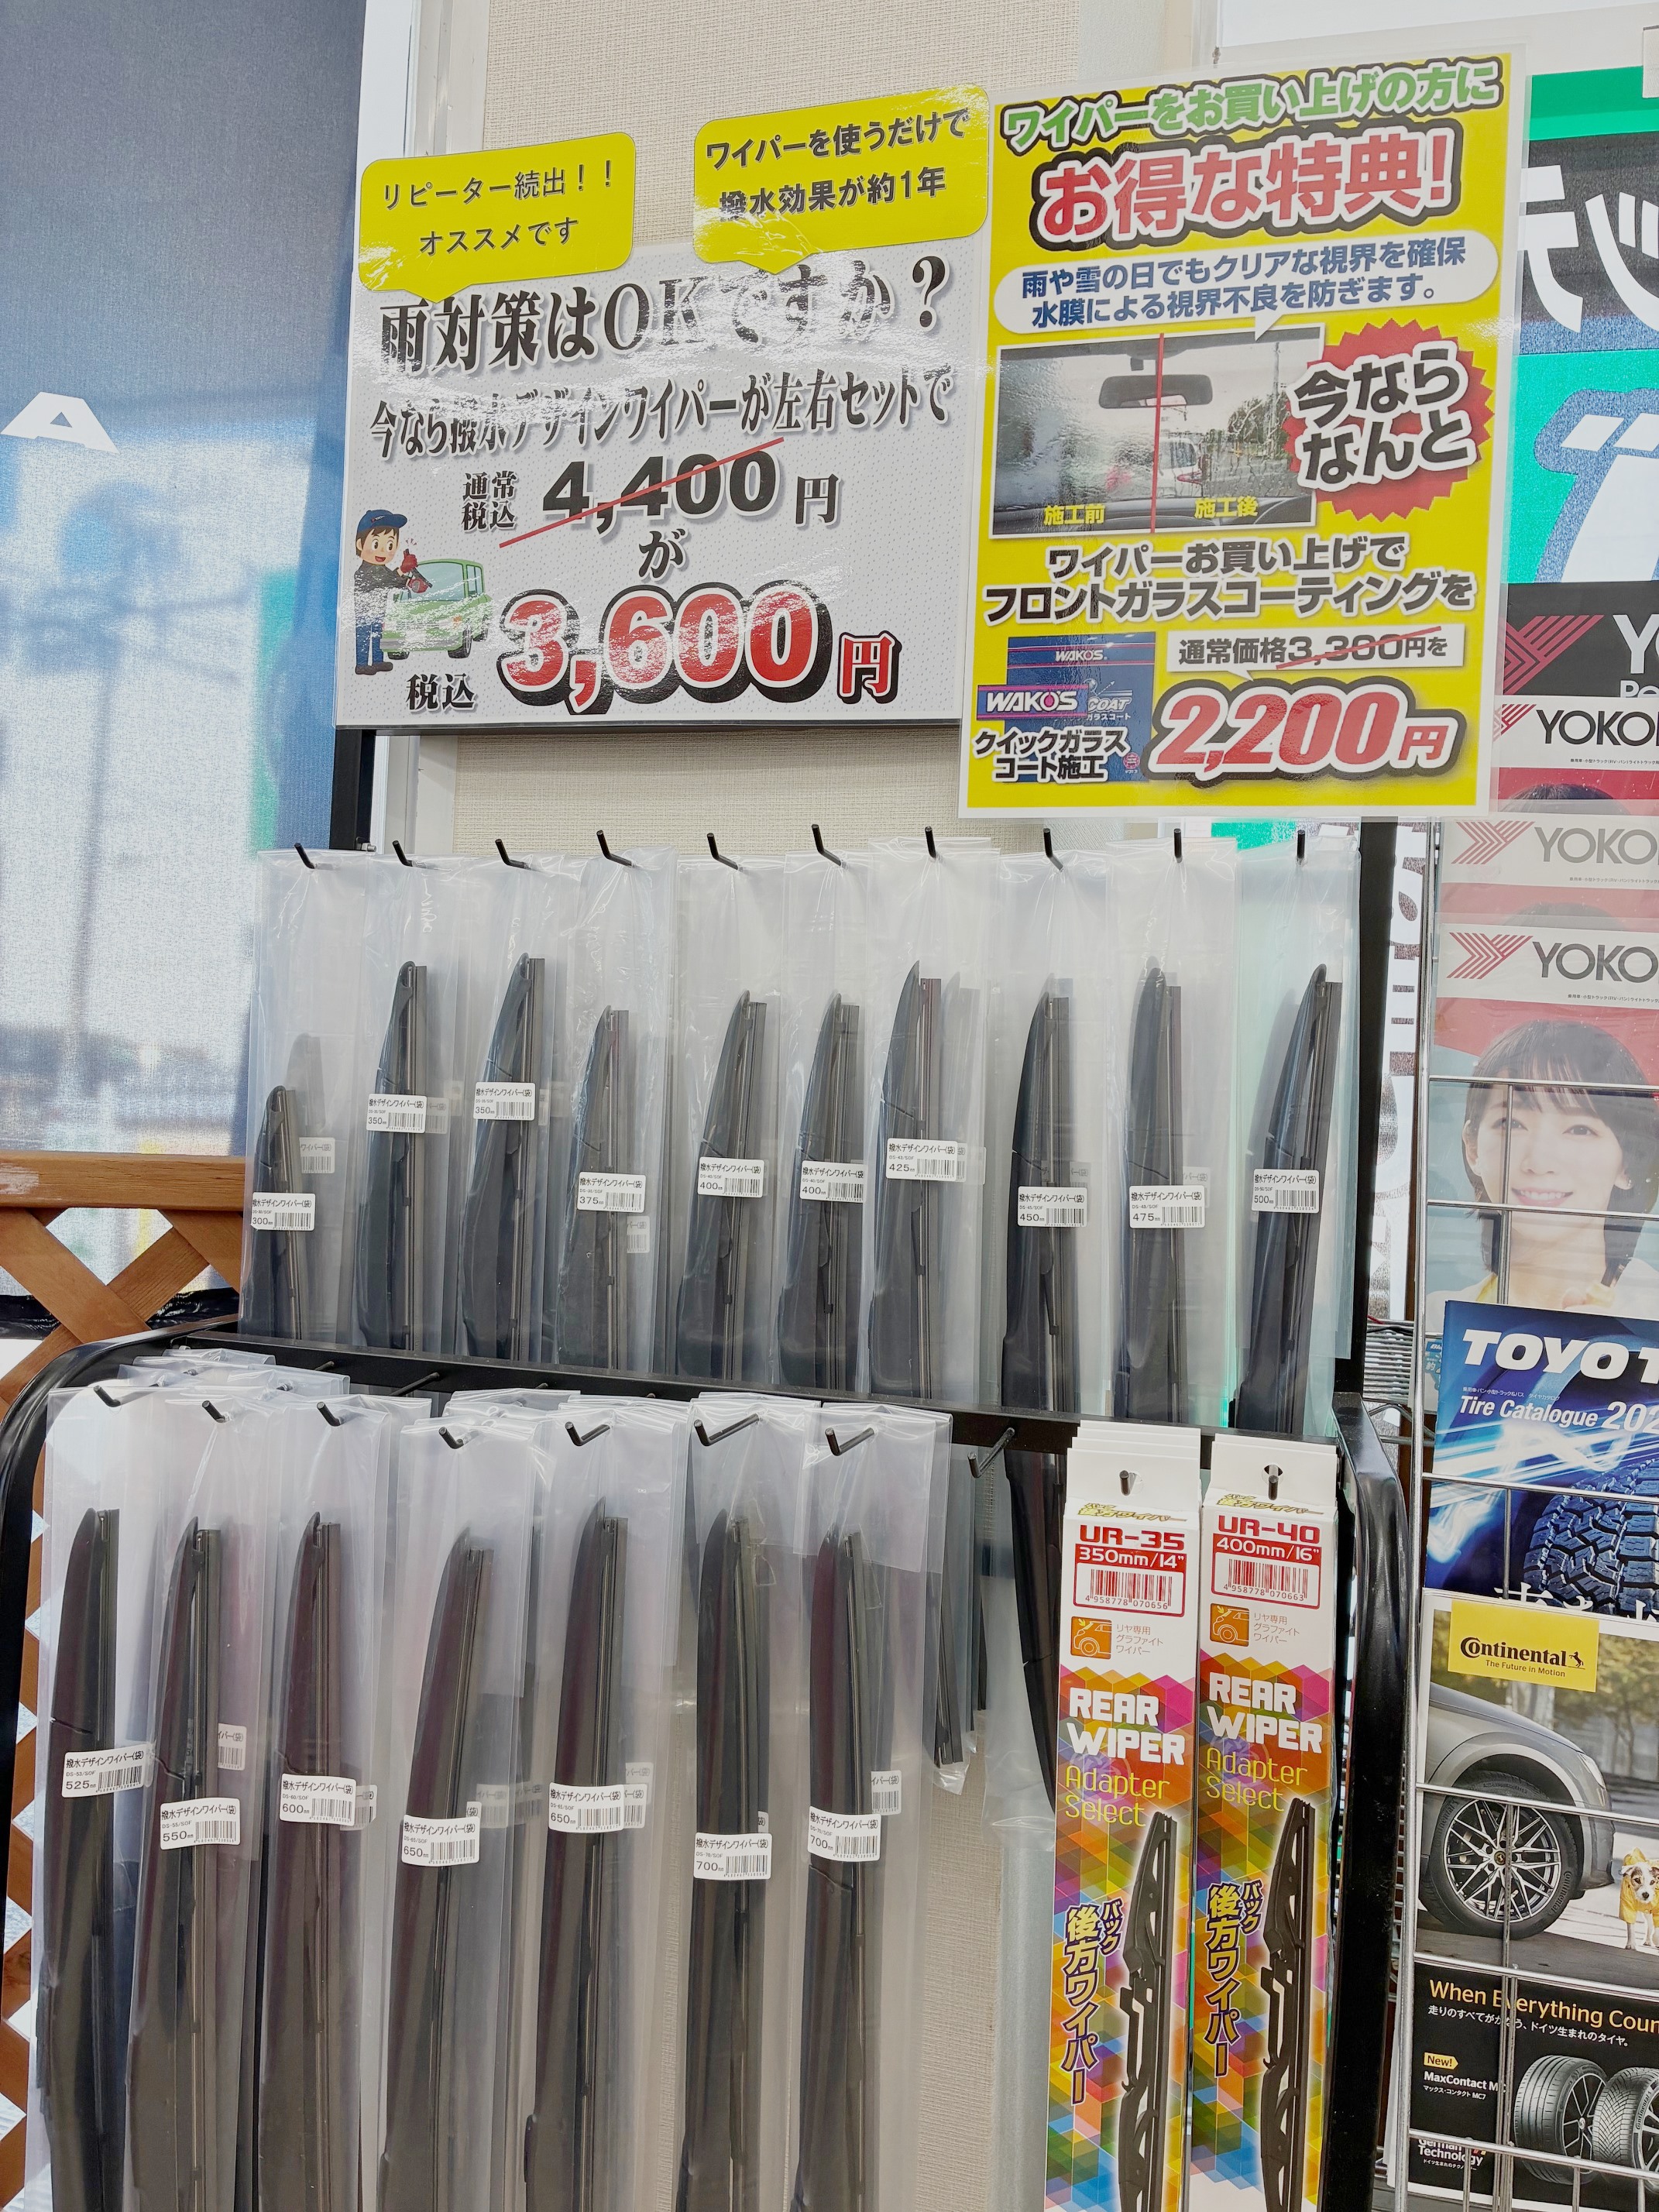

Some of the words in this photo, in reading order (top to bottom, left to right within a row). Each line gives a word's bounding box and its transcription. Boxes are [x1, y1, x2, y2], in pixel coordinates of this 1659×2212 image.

[1001, 60, 1502, 153] ワイパーをお買い上げの方に
[706, 107, 971, 170] ワイパーを使うだけで
[381, 160, 613, 211] リピーター続出!!
[718, 166, 946, 221] 撥水効果が約1年
[1036, 122, 1459, 245] お得な特典!
[418, 216, 578, 256] オススメです
[1022, 236, 1466, 299] 雨や雪の日でもクリアな視界を確保
[380, 256, 950, 374] 雨対策はOKですか?
[1032, 273, 1434, 328] 水膜による視界不良を防ぎます。
[1294, 349, 1460, 428] 今なら
[373, 366, 951, 457] 今なら撥水デザインワイパーが左右セットで
[1303, 410, 1468, 484] なんと
[465, 472, 517, 501] 通常
[462, 501, 515, 531] 税込
[1043, 503, 1105, 525] 施工前
[1195, 497, 1258, 520] 施工後
[640, 529, 687, 579] が
[1049, 534, 1407, 578] ワイパーお買い上げで
[985, 573, 1475, 623] フロントガラスコーティングを
[1179, 634, 1448, 666] 通常価格3,300円を
[1613, 614, 1659, 674] Y
[407, 675, 474, 713] 税込
[1087, 698, 1132, 712] COAT
[974, 730, 1126, 754] クイックガラス
[1536, 709, 1659, 747] YOKO
[995, 756, 1104, 779] コート施工
[1534, 826, 1659, 865] YOKO
[1532, 941, 1659, 984] YOKO
[802, 1166, 864, 1179] 撥水デザインワイパー(袋
[1462, 1329, 1629, 1380] TOYO
[1460, 1396, 1495, 1416] Tire
[1500, 1400, 1598, 1427] Catalogue
[1080, 1524, 1184, 1551] UR-35
[1218, 1515, 1321, 1544] UR-40
[1117, 1623, 1151, 1635] リヤ専用
[1254, 1623, 1300, 1636] グラファイト
[1255, 1613, 1287, 1625] リヤ専用
[1116, 1634, 1163, 1646] グラファイト
[1116, 1645, 1150, 1654] ワイパー
[1254, 1633, 1287, 1644] ワイパー
[1461, 1637, 1567, 1667] Continental
[1502, 1662, 1527, 1671] Future
[1538, 1667, 1565, 1677] Motion
[1070, 1688, 1159, 1726] REAR
[1210, 1674, 1296, 1714] REAR
[1066, 1723, 1184, 1765] WIPER
[1207, 1706, 1322, 1753] WIPER
[1065, 1764, 1170, 1800] Adapter
[1207, 1747, 1308, 1787] Adapter
[1065, 1794, 1146, 1827] Select
[1207, 1776, 1285, 1812] Select
[1240, 1880, 1262, 1936] バック
[1100, 1899, 1122, 1956] バック
[1204, 1883, 1242, 2078] 後方ワイパー
[1429, 1980, 1486, 2005] When
[1062, 1903, 1101, 2106] 後方ワイパー
[1424, 2071, 1487, 2090] MaxContact
[1427, 2056, 1453, 2067] New!
[1424, 2085, 1471, 2097] マックス・コンタクト
[1472, 2091, 1486, 2100] MC7
